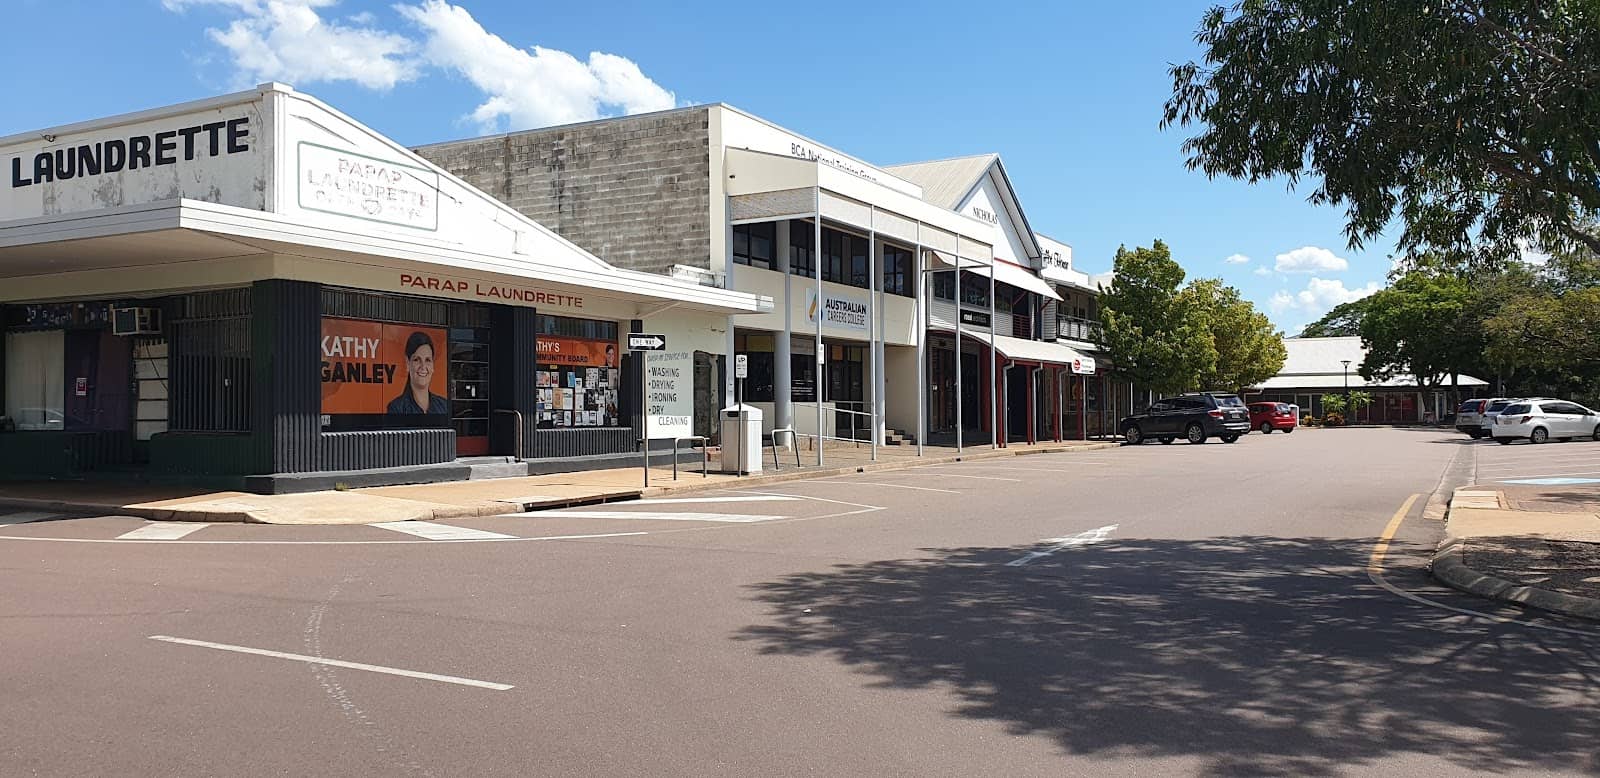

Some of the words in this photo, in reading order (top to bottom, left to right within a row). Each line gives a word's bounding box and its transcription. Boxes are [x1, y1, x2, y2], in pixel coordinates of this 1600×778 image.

[12, 117, 249, 188] LAUNDRETTE
[791, 142, 806, 160] BCA
[972, 206, 998, 225] NICHOLAS
[400, 274, 468, 293] PARAP
[476, 283, 583, 308] LAUNDRETTE
[825, 298, 867, 315] AUSTRALIAN
[320, 335, 380, 359] KATHY
[320, 360, 397, 385] GANLEY
[651, 367, 680, 378] WASHING
[651, 379, 675, 390] DRYING
[651, 392, 677, 402] IRONING
[652, 405, 665, 415] DRY
[658, 416, 688, 426] CLEANING
